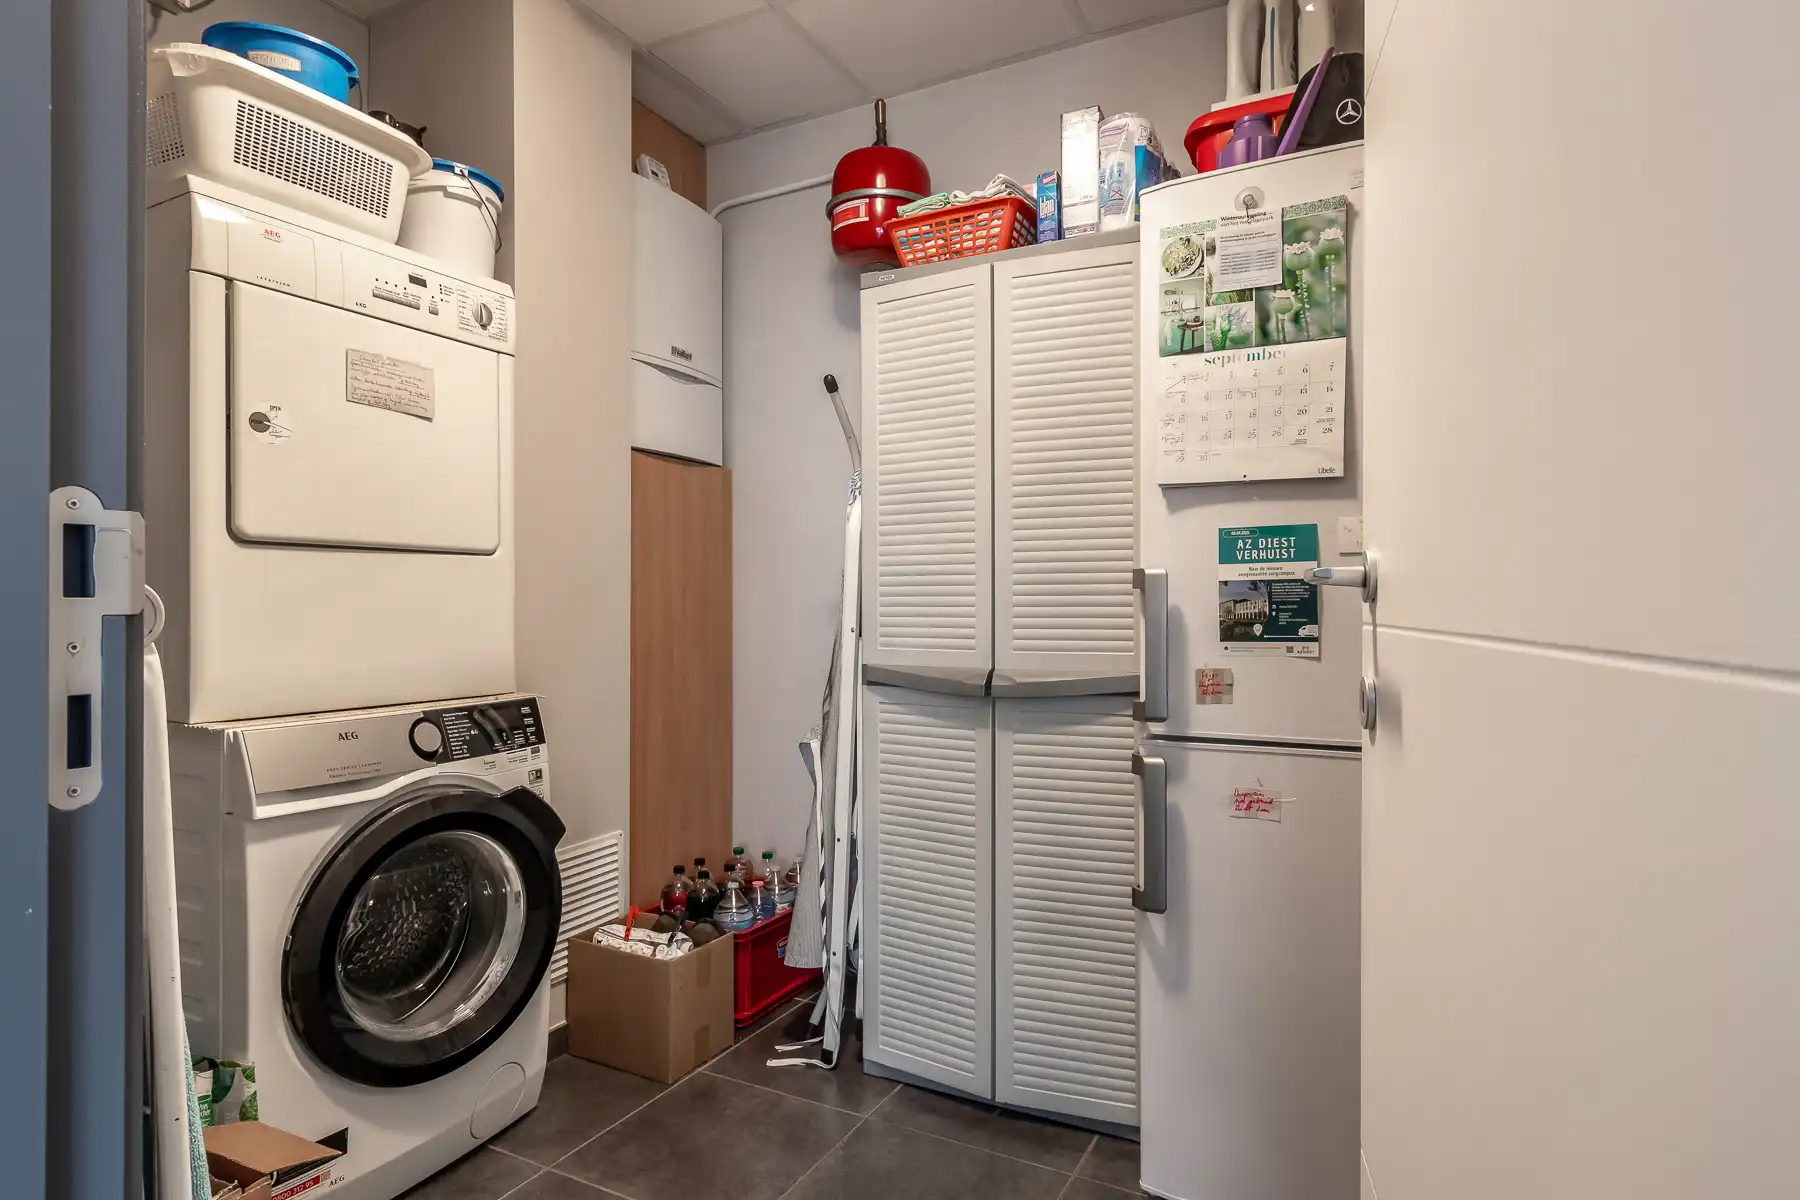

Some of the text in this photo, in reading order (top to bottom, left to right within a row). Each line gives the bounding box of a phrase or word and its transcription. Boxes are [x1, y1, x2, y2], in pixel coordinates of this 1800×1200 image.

[264, 228, 281, 238] AEG
[1237, 537, 1296, 550] AZ DIEST
[1236, 549, 1296, 560] VERHUIST
[338, 731, 358, 741] AEG
[292, 1184, 303, 1194] 312
[305, 1179, 314, 1189] 95
[329, 1175, 345, 1187] AEG
